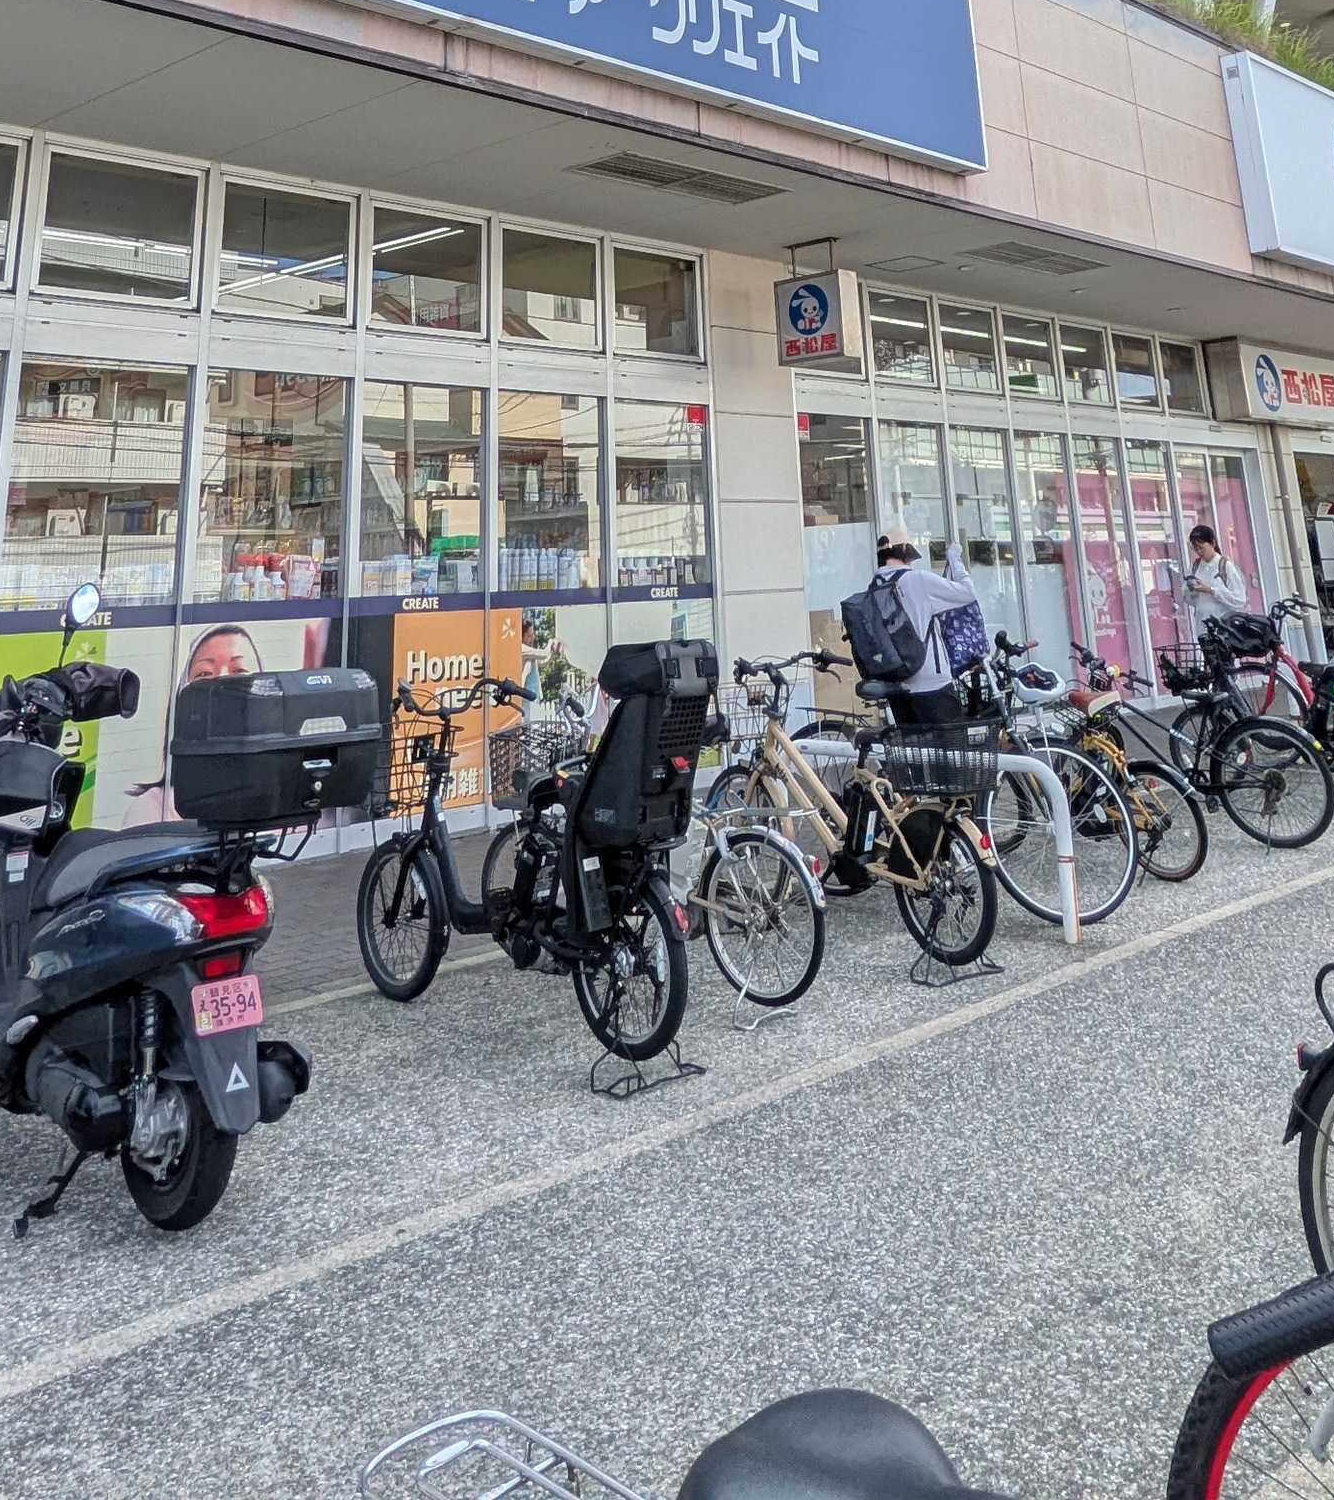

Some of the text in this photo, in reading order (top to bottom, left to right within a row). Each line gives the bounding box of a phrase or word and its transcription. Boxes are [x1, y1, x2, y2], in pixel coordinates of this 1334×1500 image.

[785, 333, 837, 357] 西松屋
[403, 597, 439, 610] CREATE
[650, 585, 679, 599] CREATE
[406, 650, 484, 684] Home
[210, 991, 257, 1018] 35-94
